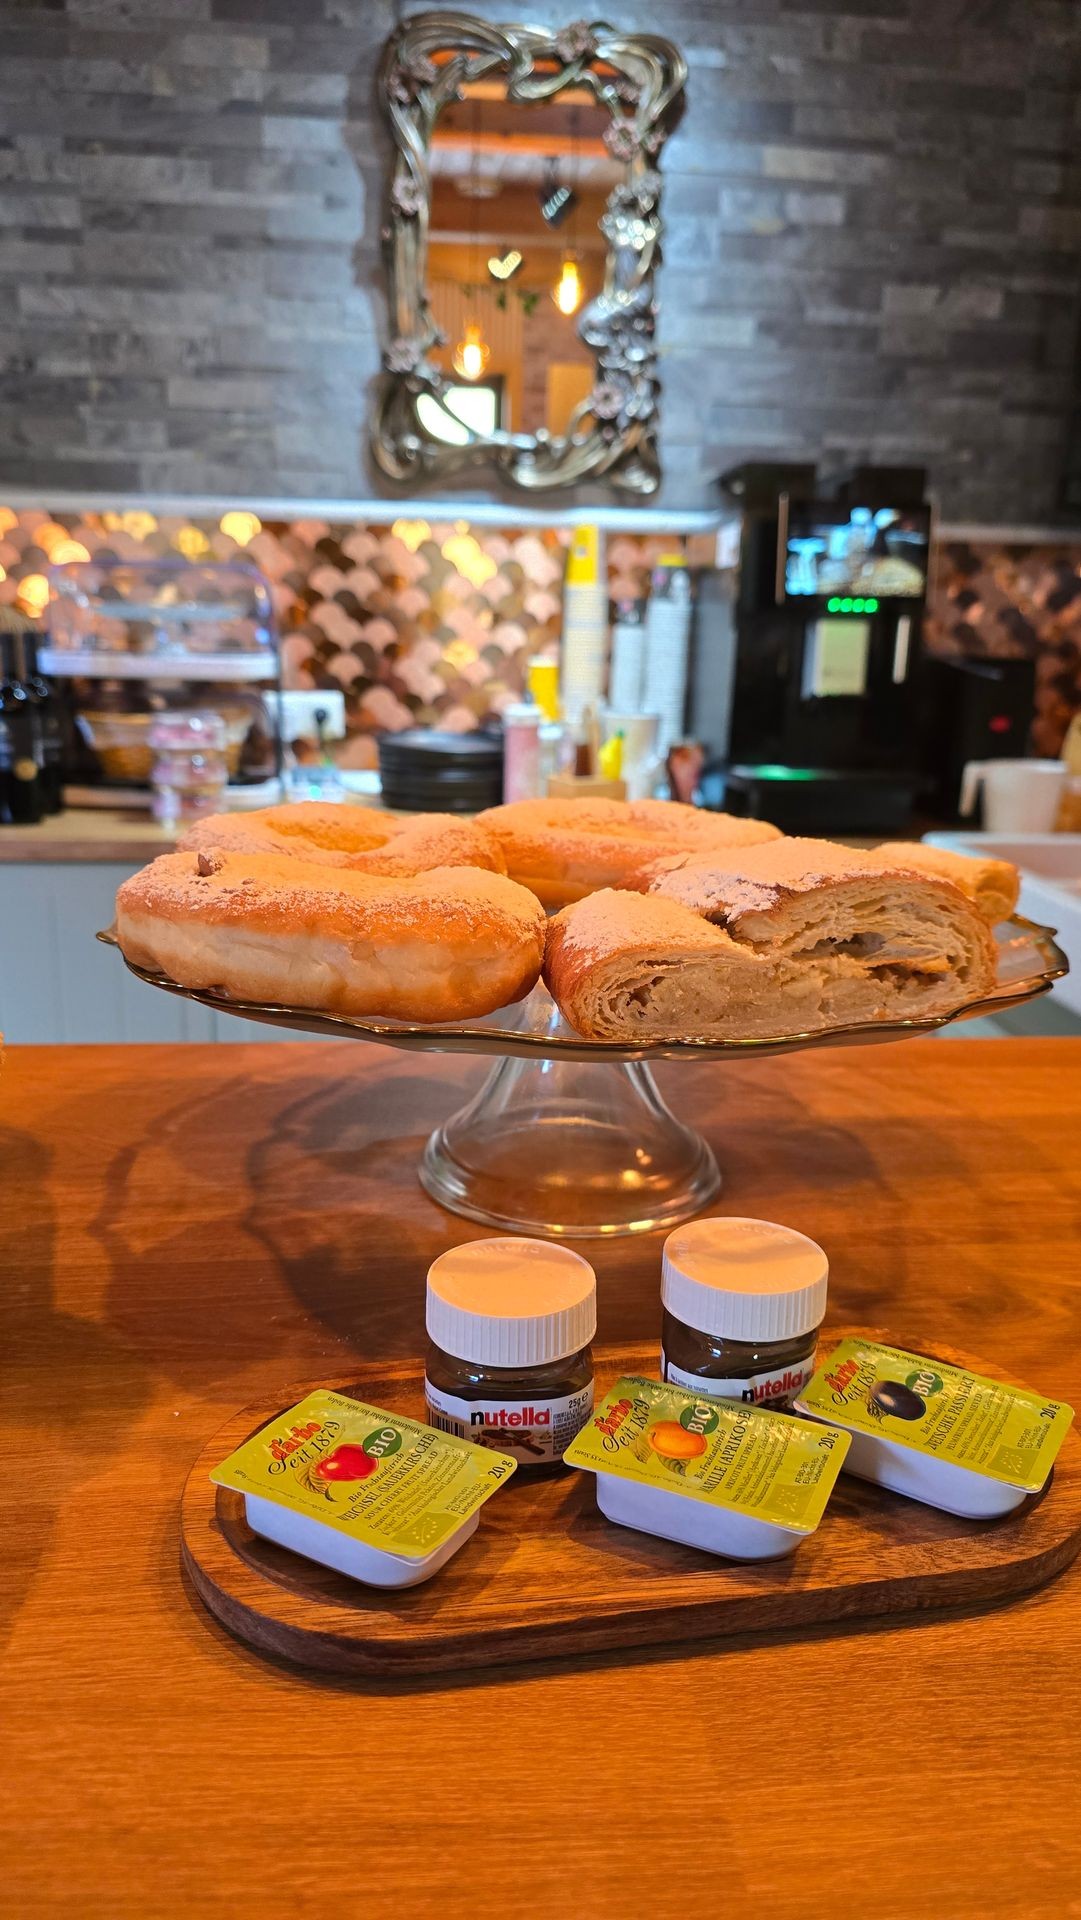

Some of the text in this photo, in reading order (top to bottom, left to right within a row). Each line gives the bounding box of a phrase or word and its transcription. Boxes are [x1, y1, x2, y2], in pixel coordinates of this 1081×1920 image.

[742, 1371, 803, 1402] nutella
[831, 1384, 864, 1405] Seit
[912, 1371, 935, 1396] BIO
[948, 1376, 975, 1415] PASSIERT
[568, 1396, 581, 1409] 25g
[1040, 1408, 1056, 1419] 20
[471, 1407, 550, 1426] nutella
[603, 1399, 650, 1452] Seit 1879
[687, 1405, 713, 1434] BIO
[268, 1421, 340, 1474] Seit 1879
[366, 1429, 396, 1456] BIO
[718, 1410, 755, 1465] (APRIKOSE)
[818, 1437, 835, 1449] 20
[417, 1451, 438, 1475] SPREAD
[488, 1460, 513, 1479] 20 g
[348, 1492, 362, 1503] Bio
